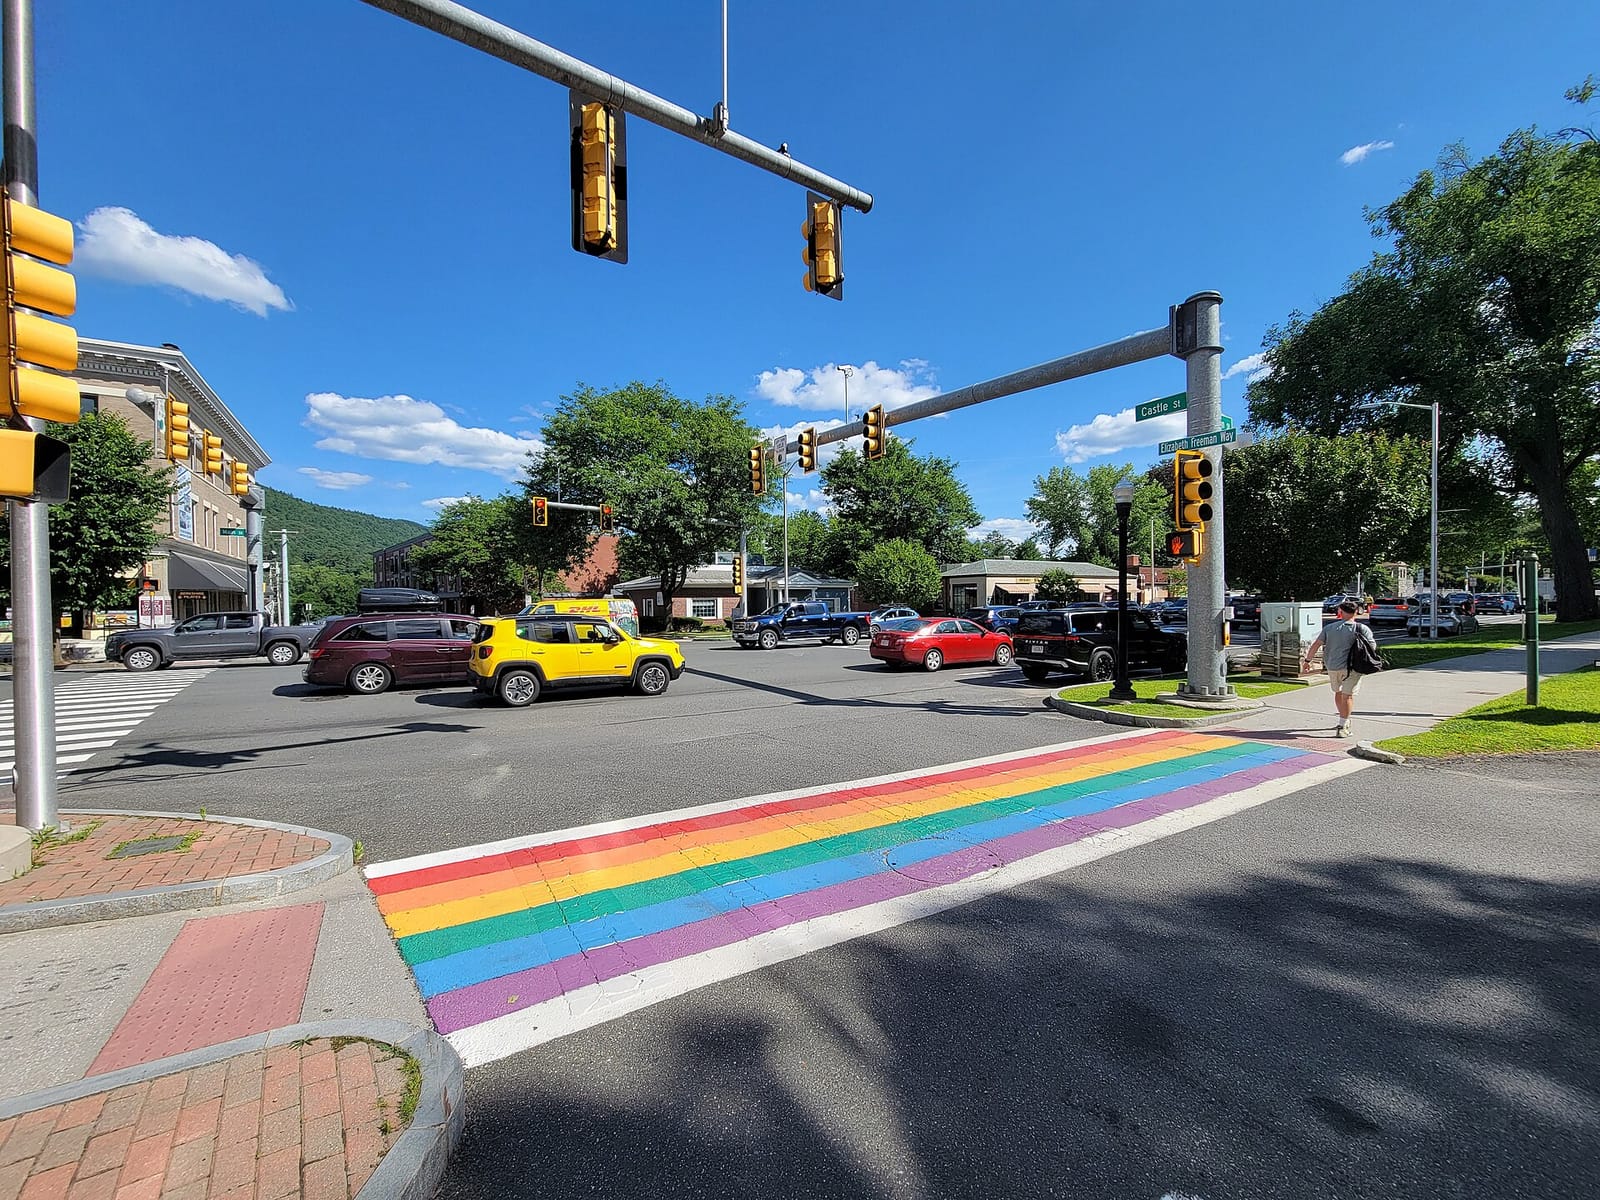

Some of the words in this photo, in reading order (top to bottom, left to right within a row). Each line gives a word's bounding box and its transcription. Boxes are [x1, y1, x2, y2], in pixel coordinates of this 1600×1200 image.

[1141, 402, 1168, 417] Castle
[1161, 440, 1188, 453] Elizabeth
[1191, 436, 1217, 447] Freeman
[1220, 431, 1234, 442] Way
